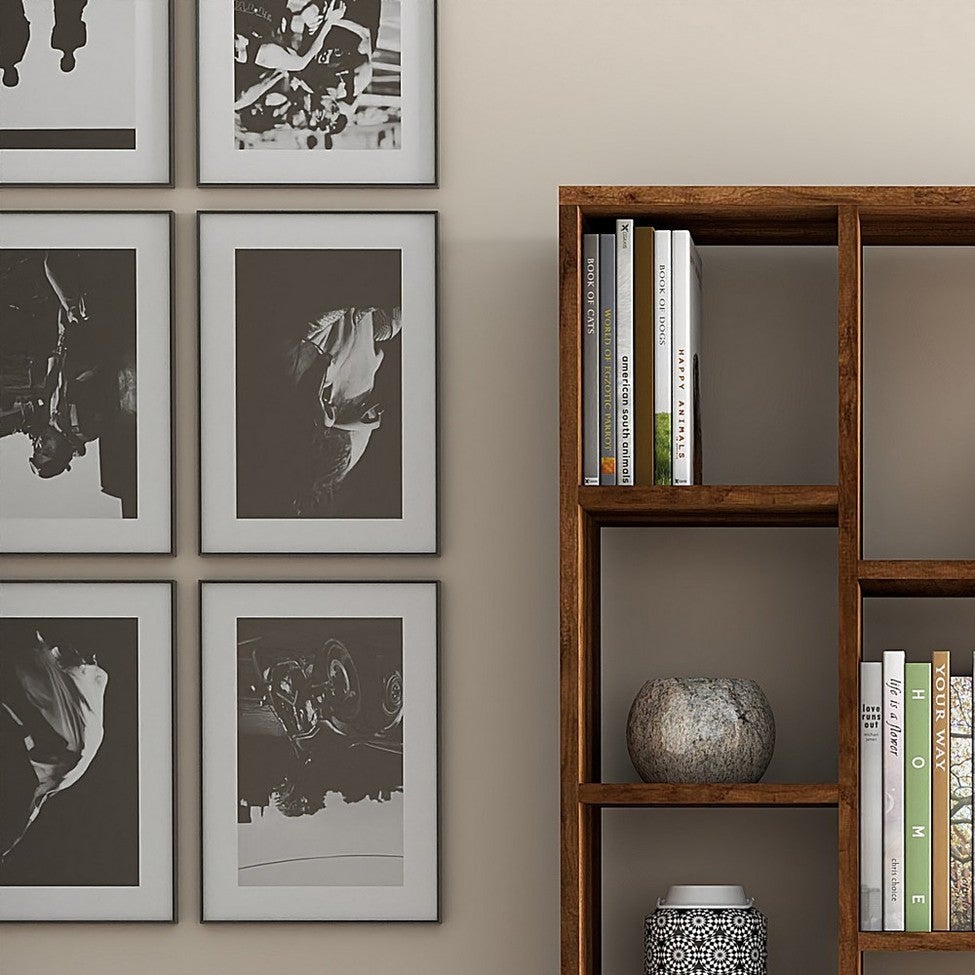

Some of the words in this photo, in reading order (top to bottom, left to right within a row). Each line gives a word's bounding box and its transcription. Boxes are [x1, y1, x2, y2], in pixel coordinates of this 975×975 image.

[587, 291, 594, 306] OF
[659, 298, 666, 312] OF
[603, 309, 612, 345] WORLD
[605, 349, 612, 363] OF
[622, 356, 630, 405] american
[622, 409, 630, 438] south
[622, 442, 631, 483] animals
[886, 679, 901, 696] life
[935, 664, 945, 722] YOUR
[863, 704, 880, 712] love
[889, 700, 899, 708] is
[886, 722, 901, 756] flower
[935, 729, 945, 772] WAY
[891, 858, 899, 876] chris
[891, 878, 899, 901] choice
